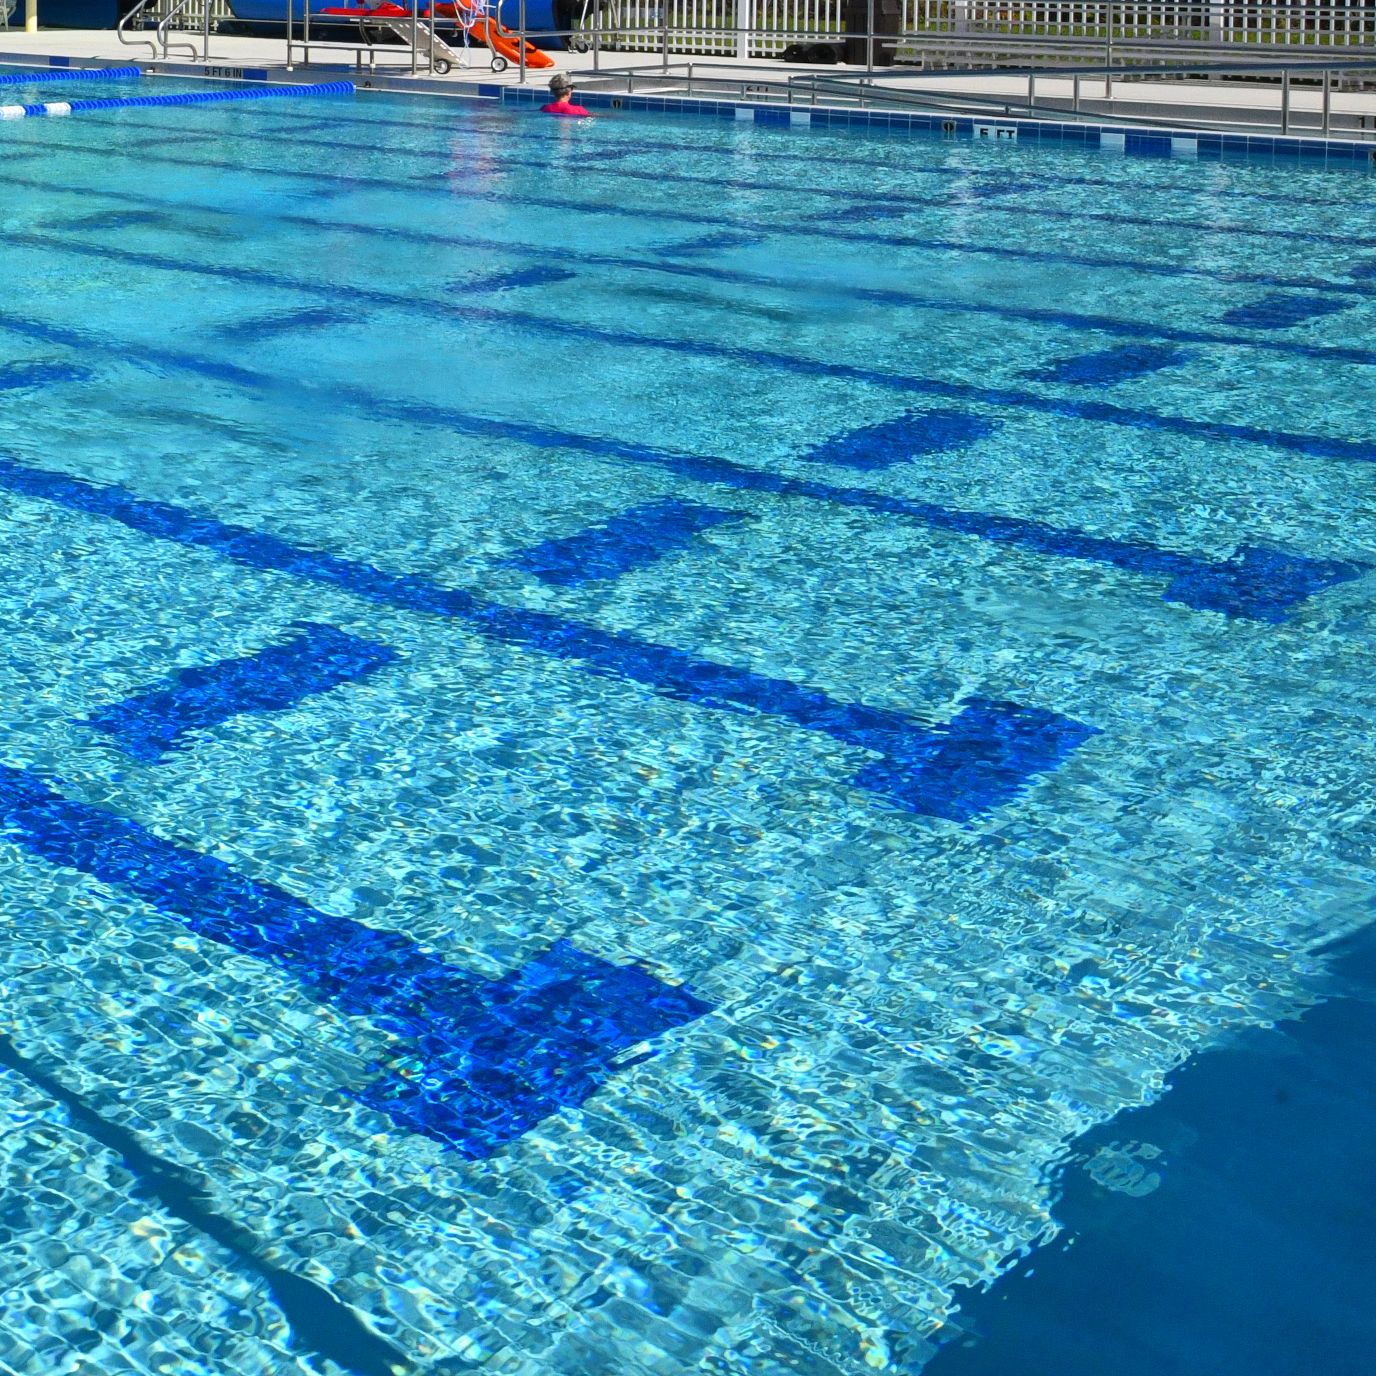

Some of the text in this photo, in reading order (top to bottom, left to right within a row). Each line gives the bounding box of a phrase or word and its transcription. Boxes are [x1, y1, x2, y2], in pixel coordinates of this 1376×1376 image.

[204, 66, 210, 77] 5
[212, 66, 222, 77] FT
[233, 67, 242, 78] IN
